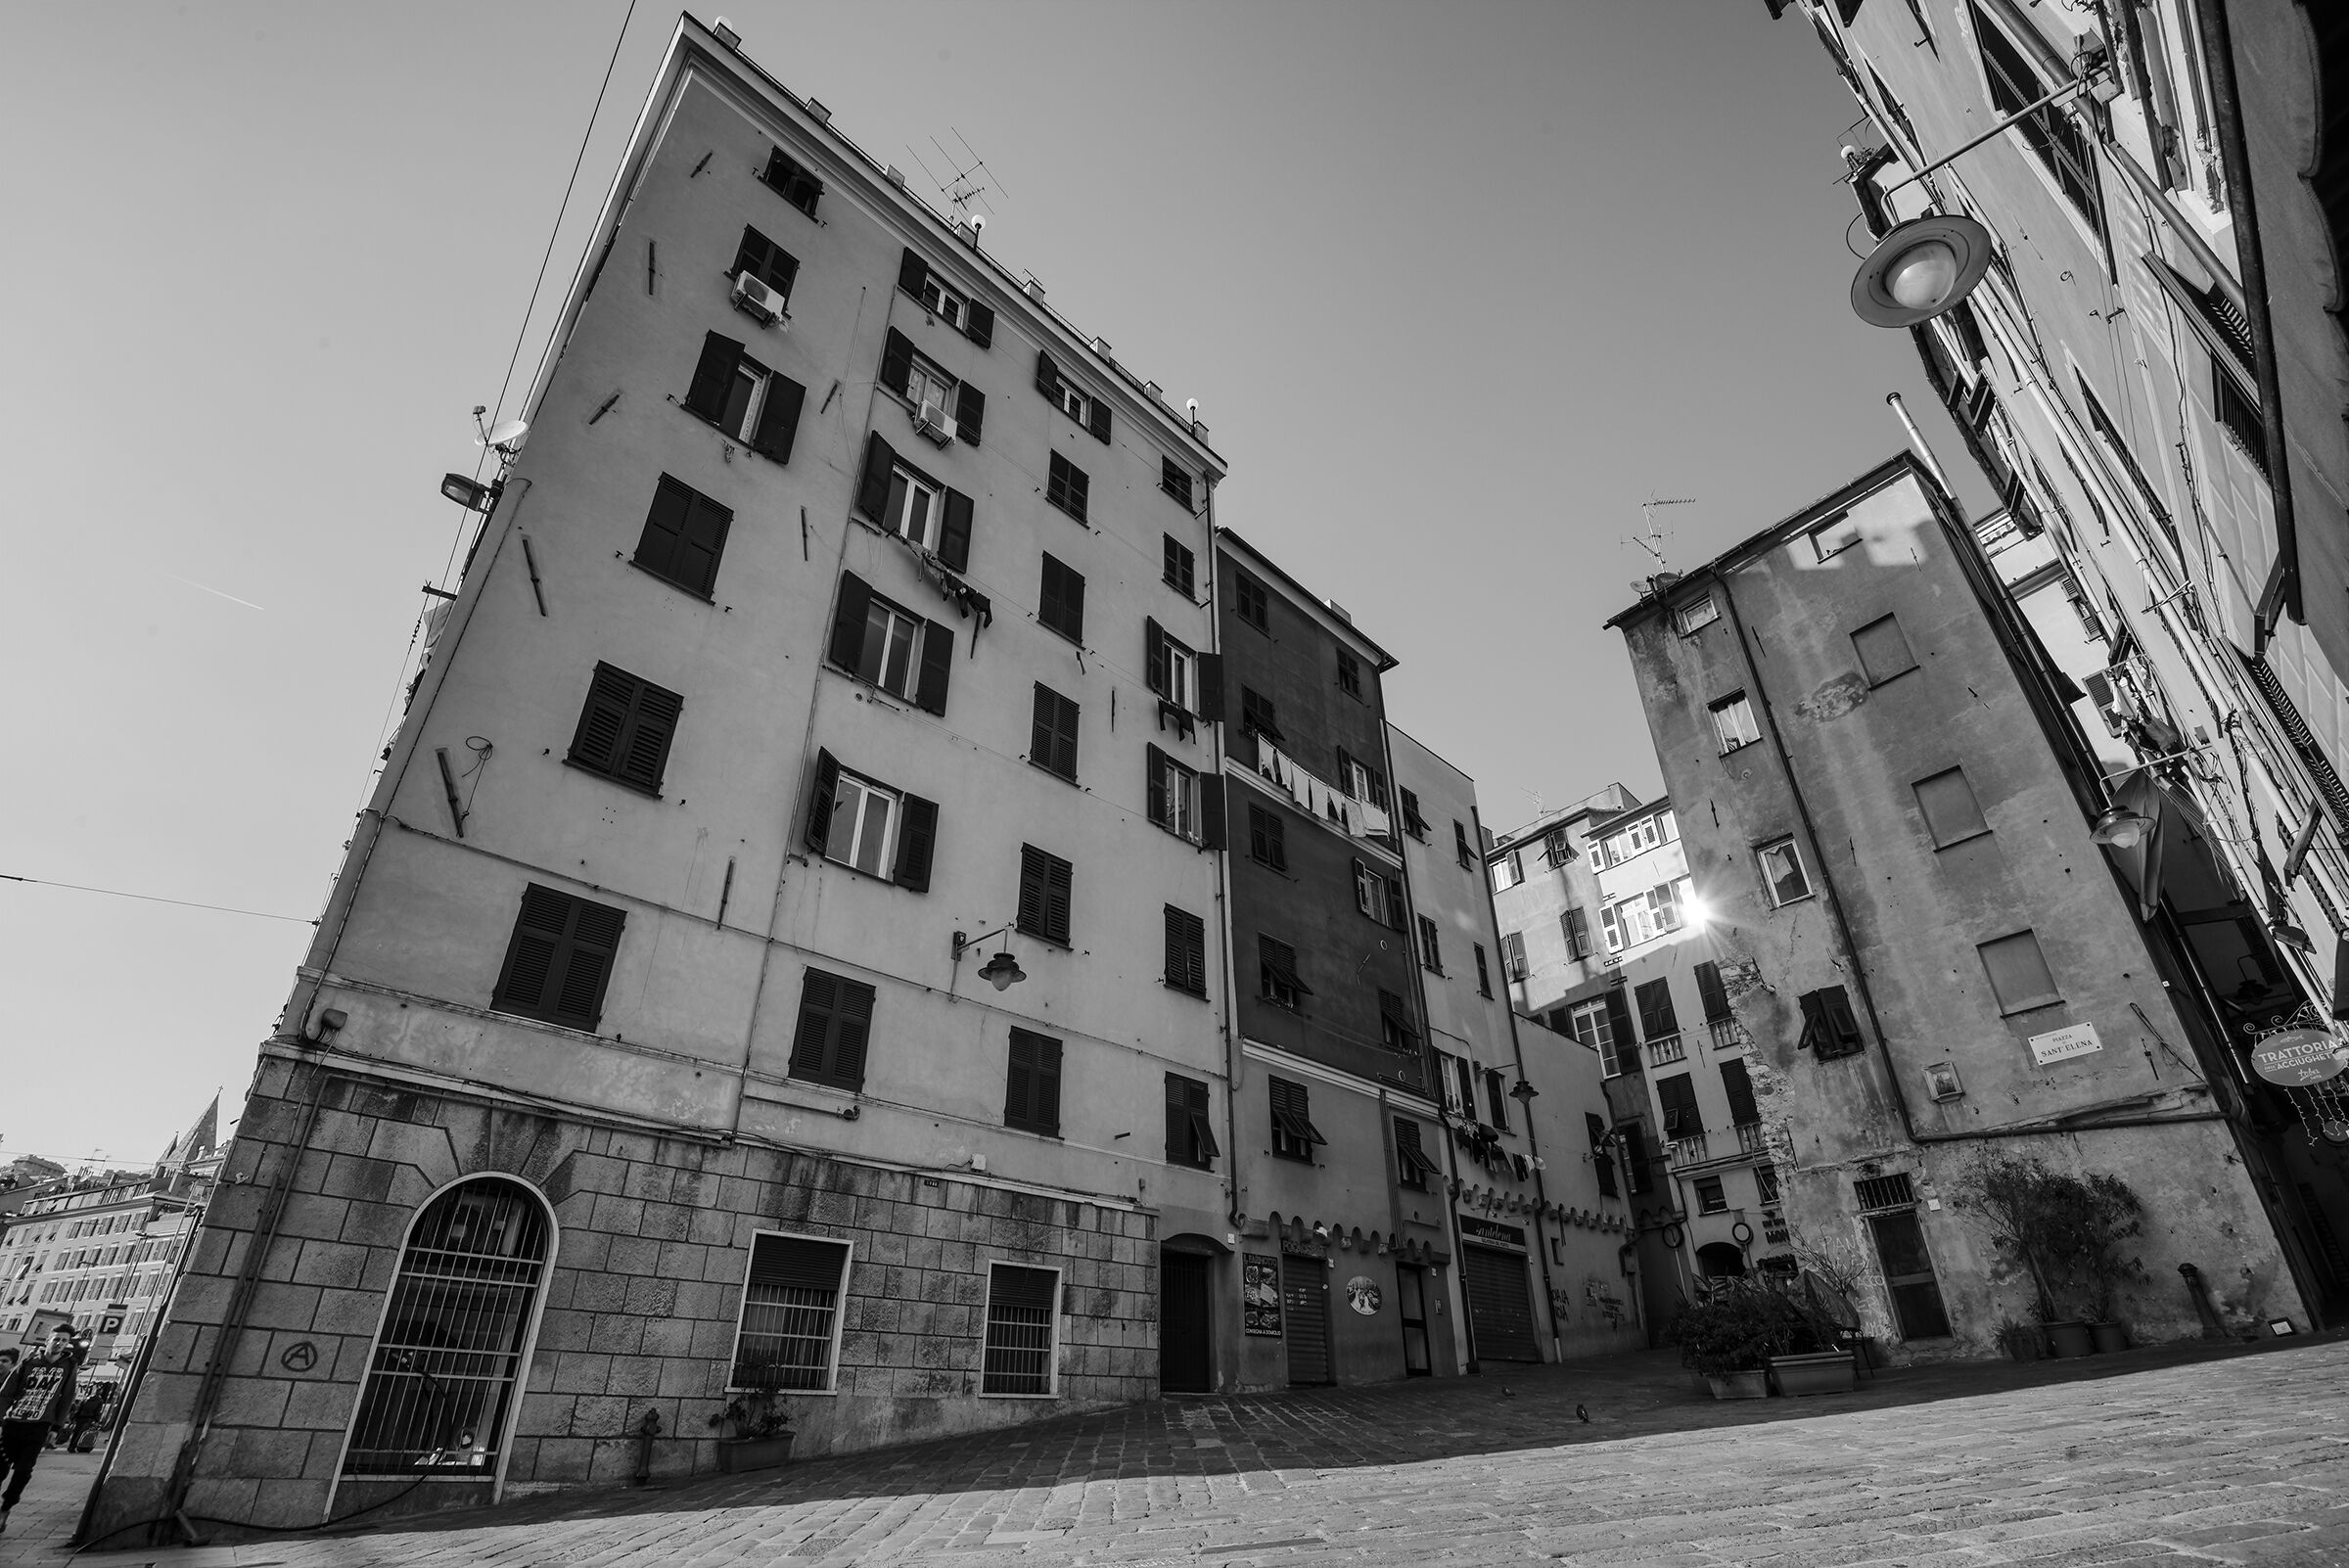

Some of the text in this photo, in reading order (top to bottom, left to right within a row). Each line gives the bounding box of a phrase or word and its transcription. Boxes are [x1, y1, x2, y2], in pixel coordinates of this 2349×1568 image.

[2051, 1034, 2072, 1042] PIAZZA
[2257, 1039, 2338, 1063] TRATTORIA
[103, 1317, 119, 1332] P
